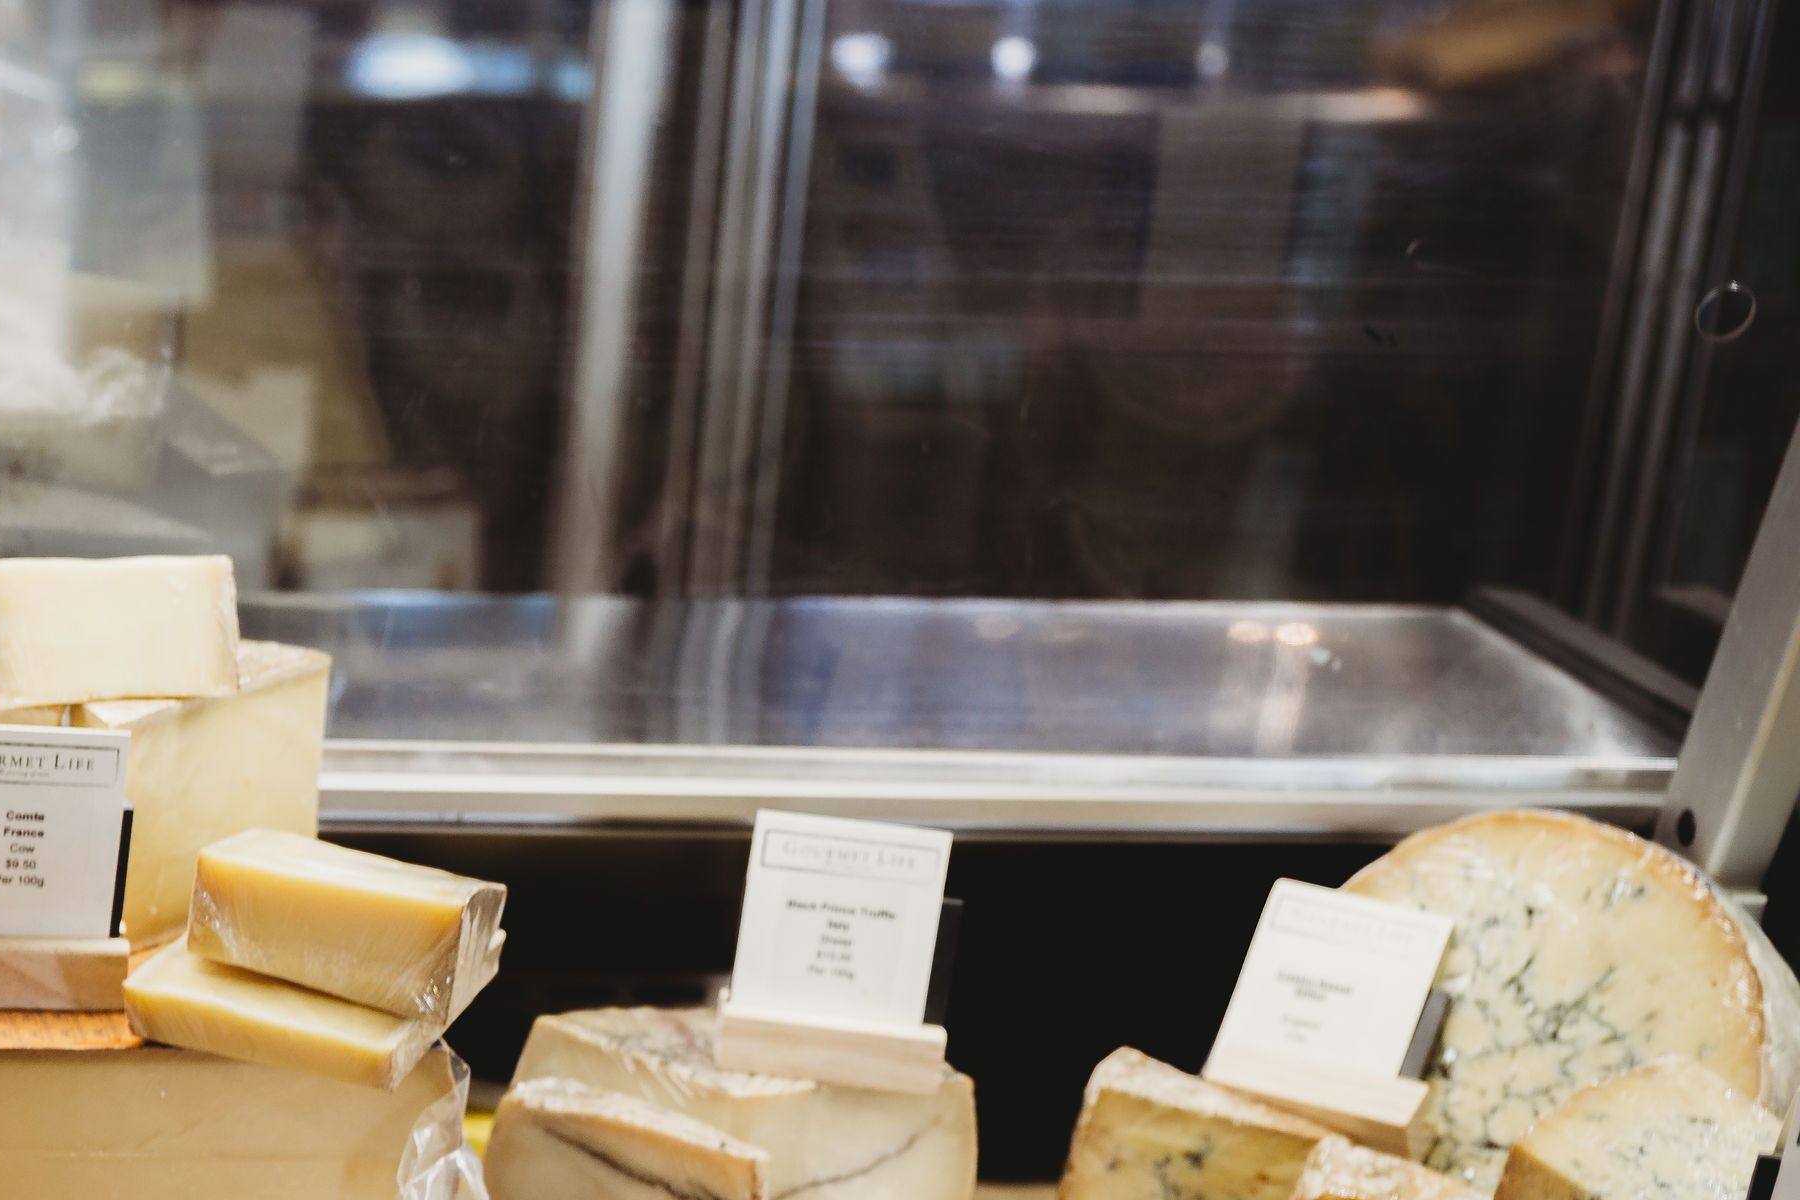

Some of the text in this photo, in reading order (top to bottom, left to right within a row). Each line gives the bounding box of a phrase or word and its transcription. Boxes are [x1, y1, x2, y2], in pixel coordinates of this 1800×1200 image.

[3, 827, 45, 838] France
[10, 843, 35, 853] Cow
[18, 876, 45, 888] 100g
